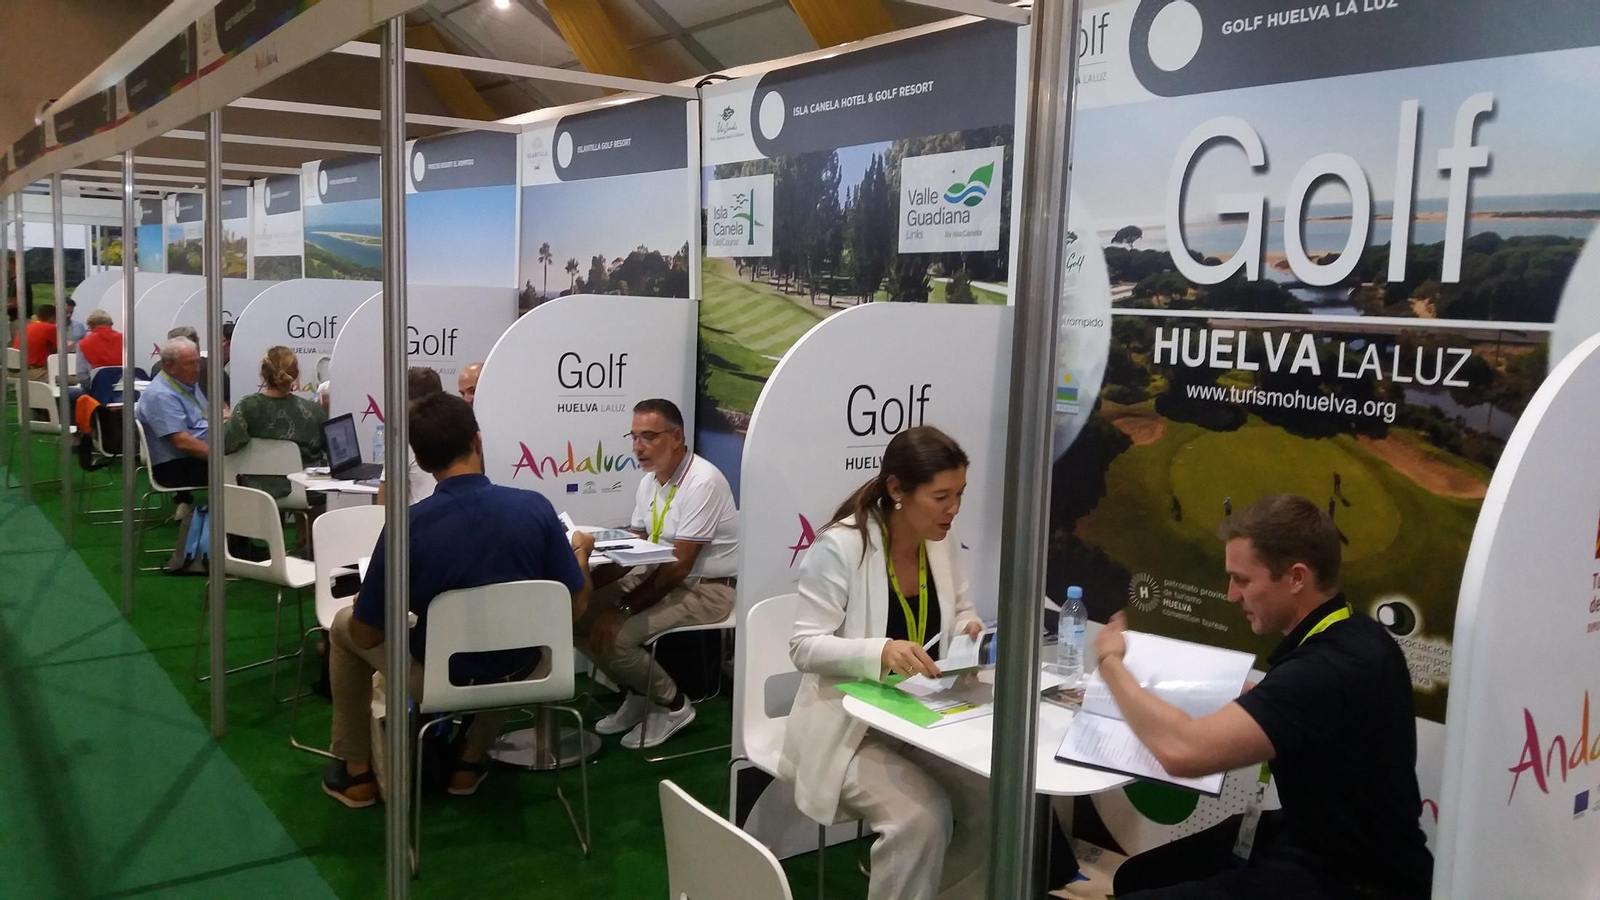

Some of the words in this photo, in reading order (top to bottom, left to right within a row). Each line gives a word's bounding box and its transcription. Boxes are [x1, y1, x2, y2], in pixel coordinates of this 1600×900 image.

[1221, 15, 1263, 35] GOLF
[1266, 6, 1330, 29] HUELVA
[1335, 1, 1358, 17] LA
[793, 105, 809, 117] ISLA
[810, 99, 840, 114] CANELA
[841, 95, 866, 108] HOTEL
[868, 94, 874, 103] &
[875, 89, 897, 102] GOLF
[899, 81, 933, 98] RESORT
[601, 140, 613, 150] GOLF
[613, 137, 631, 148] RESORT
[908, 189, 939, 206] Valle
[1166, 92, 1493, 287] Golf
[713, 206, 728, 220] Isla
[907, 206, 970, 227] Guadiana
[713, 221, 743, 236] Canela
[905, 229, 924, 240] Links
[287, 314, 337, 339] Golf
[1067, 316, 1104, 329] rompido
[407, 325, 459, 357] Golf
[1153, 326, 1322, 376] HUELVA
[558, 351, 628, 389] Golf
[558, 402, 598, 413] HUELVA
[846, 383, 932, 437] Golf
[1186, 384, 1397, 425] www.turismohuelva.org
[845, 456, 883, 470] HUEL
[1139, 585, 1149, 599] H
[1163, 579, 1199, 593] patronato
[1200, 587, 1228, 601] provinc
[1163, 588, 1172, 597] de
[1174, 590, 1203, 605] turismo
[1162, 597, 1192, 613] HUELVA
[1162, 608, 1201, 624] convention
[1202, 617, 1229, 632] bureau
